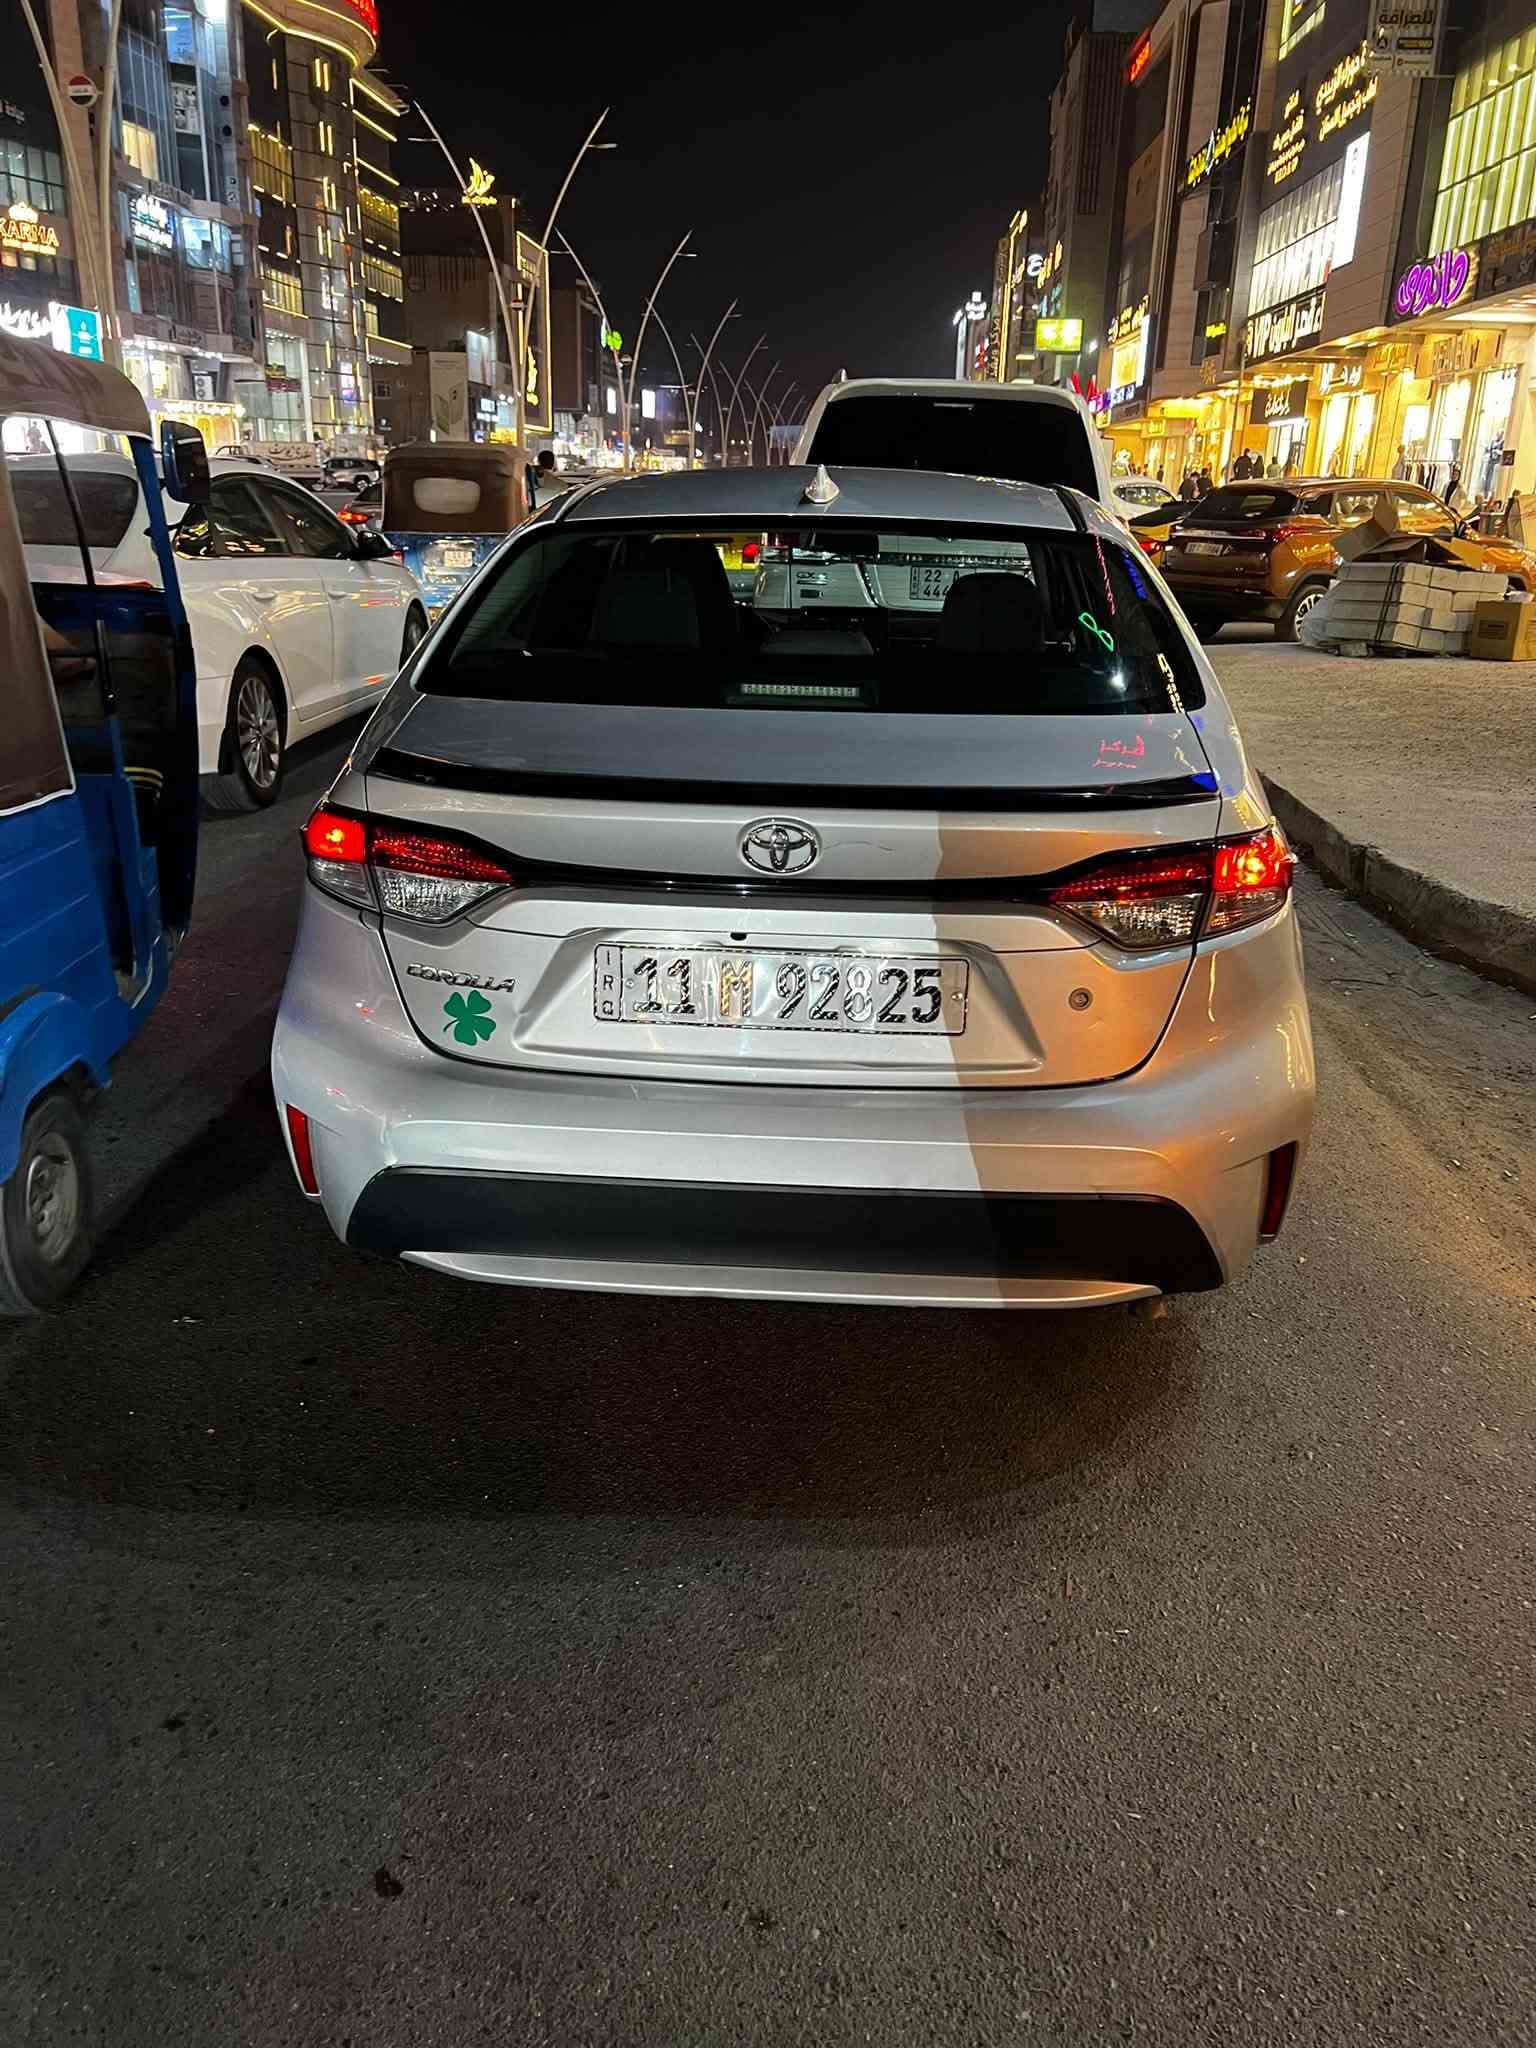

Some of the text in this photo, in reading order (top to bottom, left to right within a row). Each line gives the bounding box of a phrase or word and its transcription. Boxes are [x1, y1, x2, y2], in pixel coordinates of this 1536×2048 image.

[923, 569, 942, 582] 22
[406, 963, 516, 993] COROLLA
[632, 957, 943, 1024] 11 M 92825
